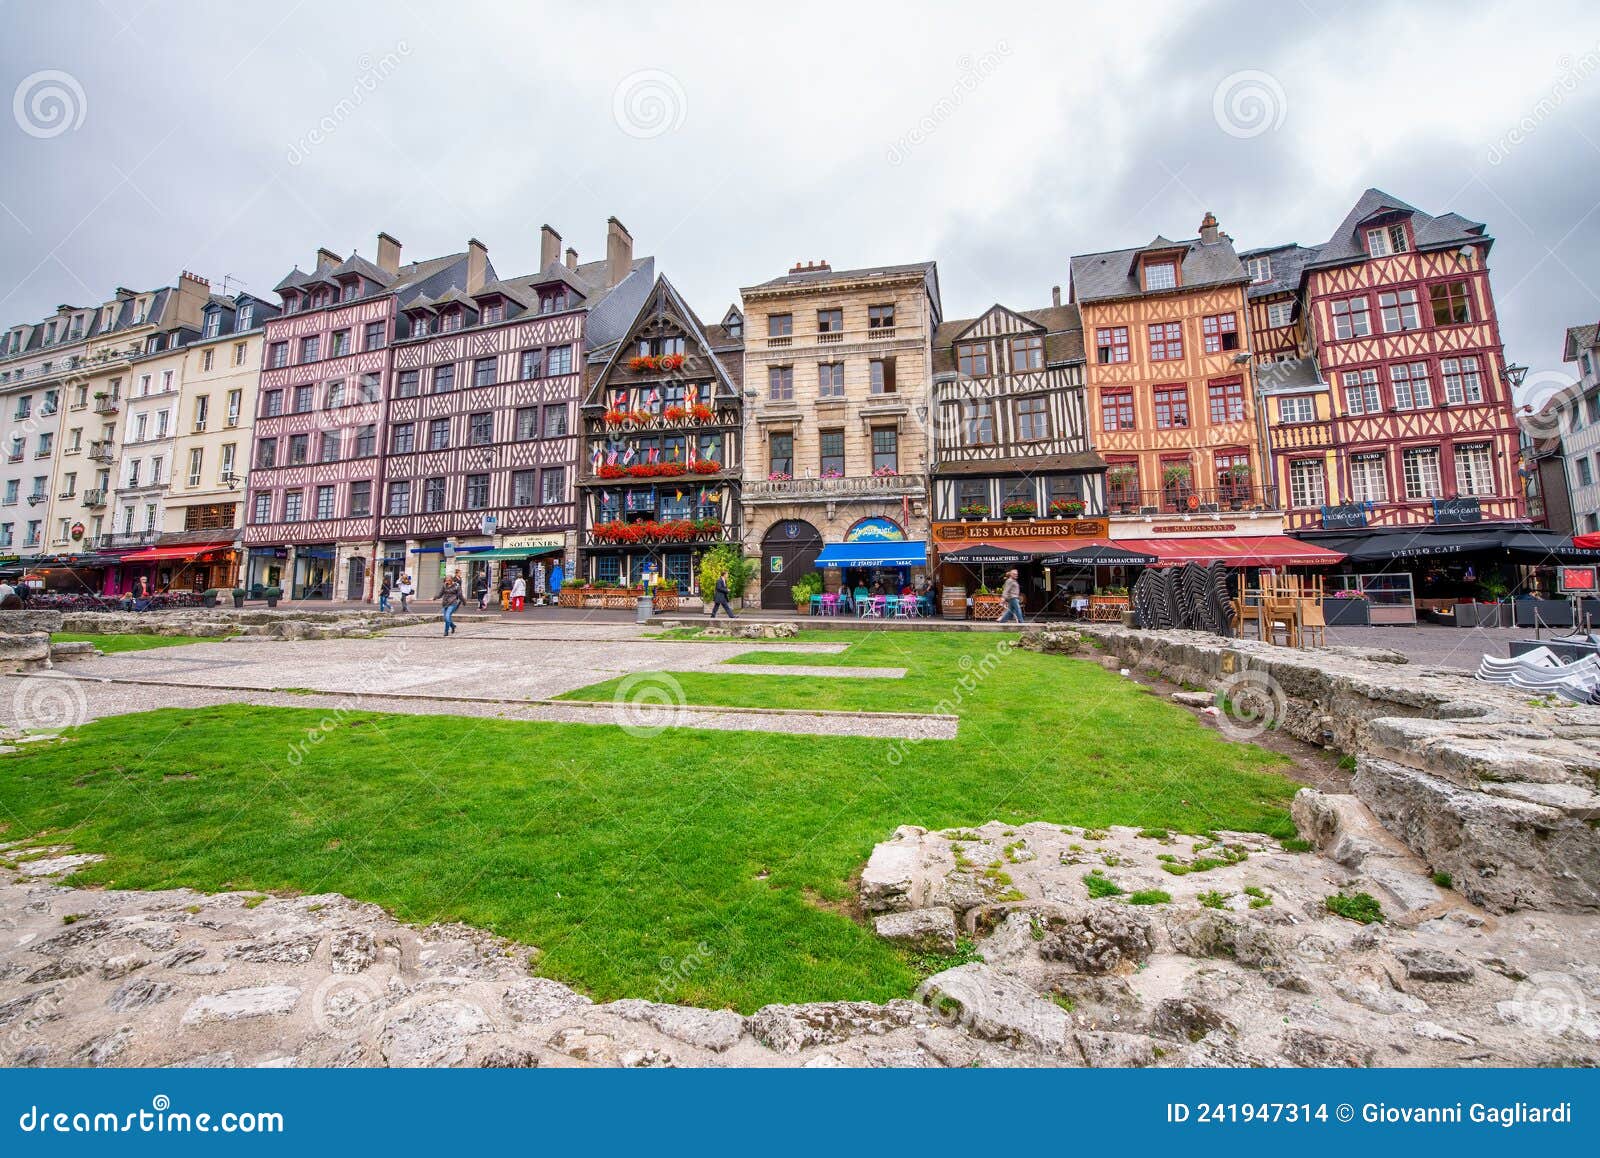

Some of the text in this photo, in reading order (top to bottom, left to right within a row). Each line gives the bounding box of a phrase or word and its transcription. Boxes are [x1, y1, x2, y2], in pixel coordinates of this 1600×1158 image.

[970, 528, 989, 537] LES
[993, 525, 1068, 536] MARAICHERS
[1391, 547, 1430, 558] L'EURO
